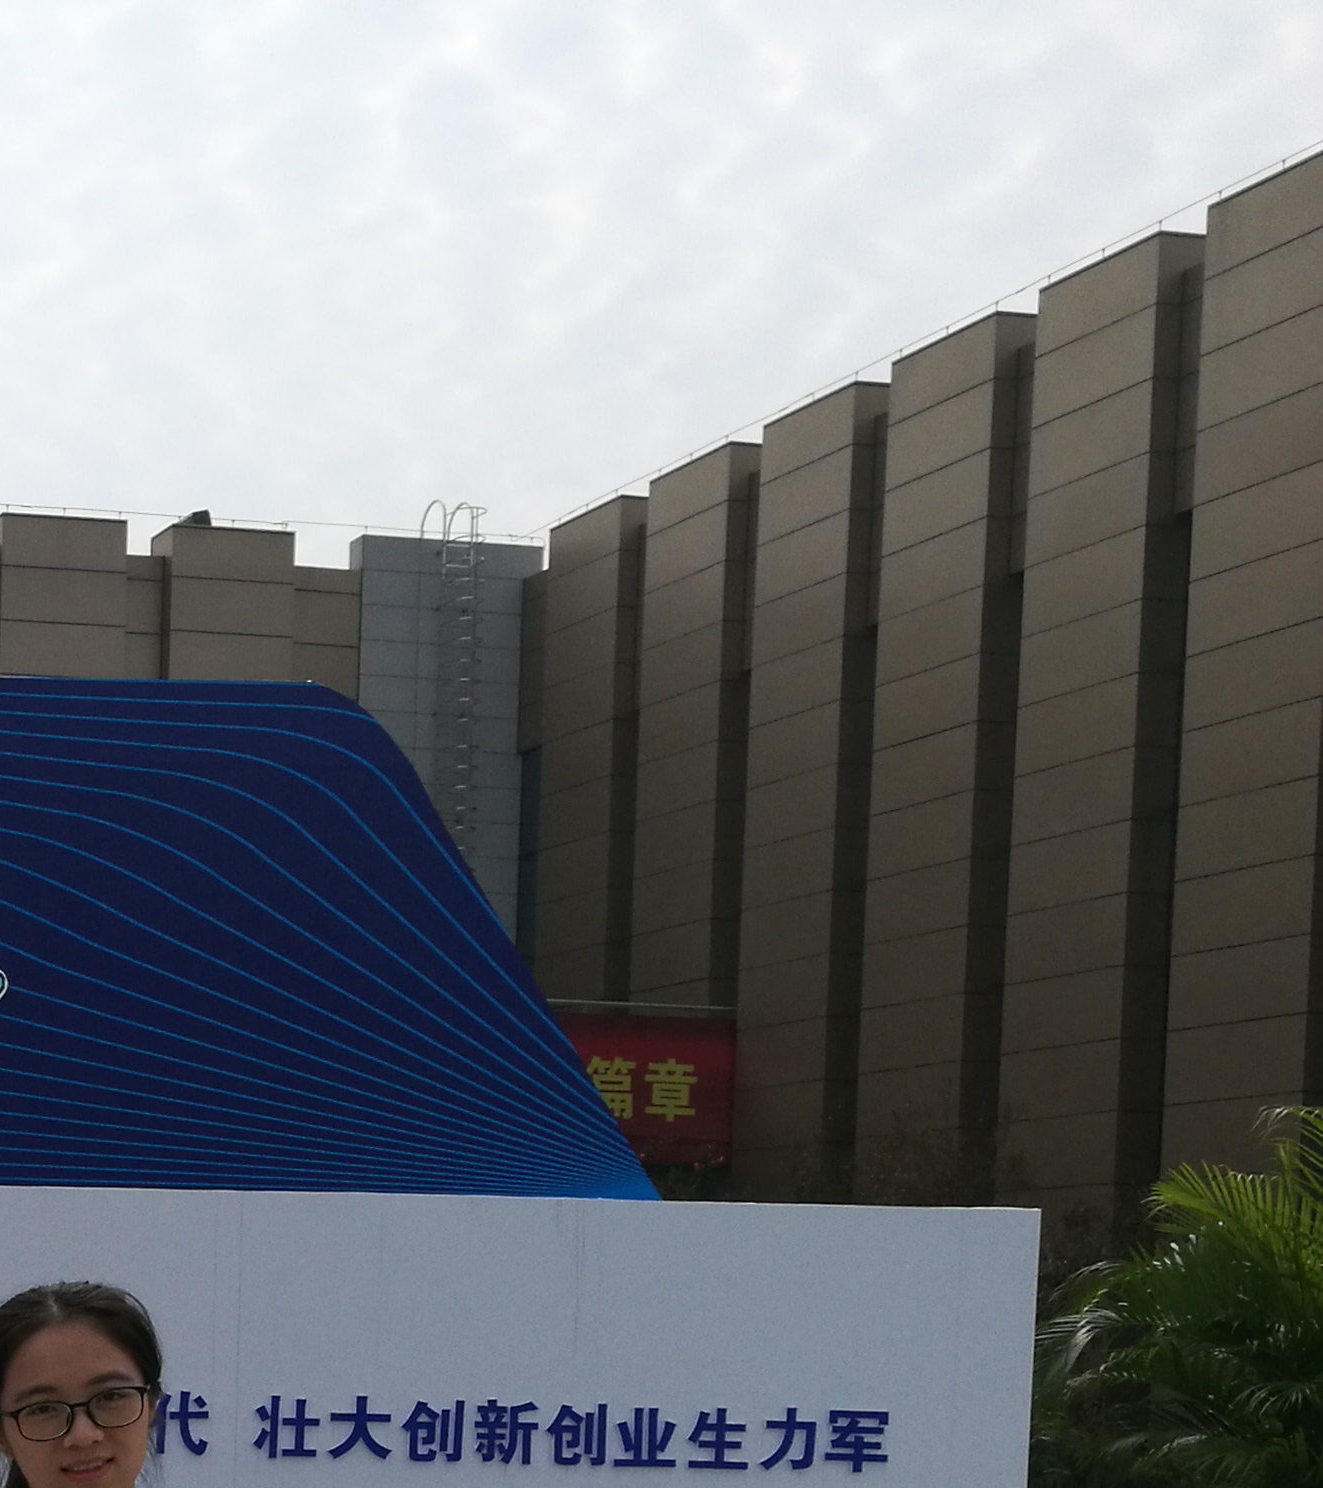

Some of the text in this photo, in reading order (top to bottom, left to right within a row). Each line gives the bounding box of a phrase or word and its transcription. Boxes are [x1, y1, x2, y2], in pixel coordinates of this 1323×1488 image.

[585, 1055, 699, 1123] 篇章
[253, 1394, 890, 1473] 壮大创新创业生力军
